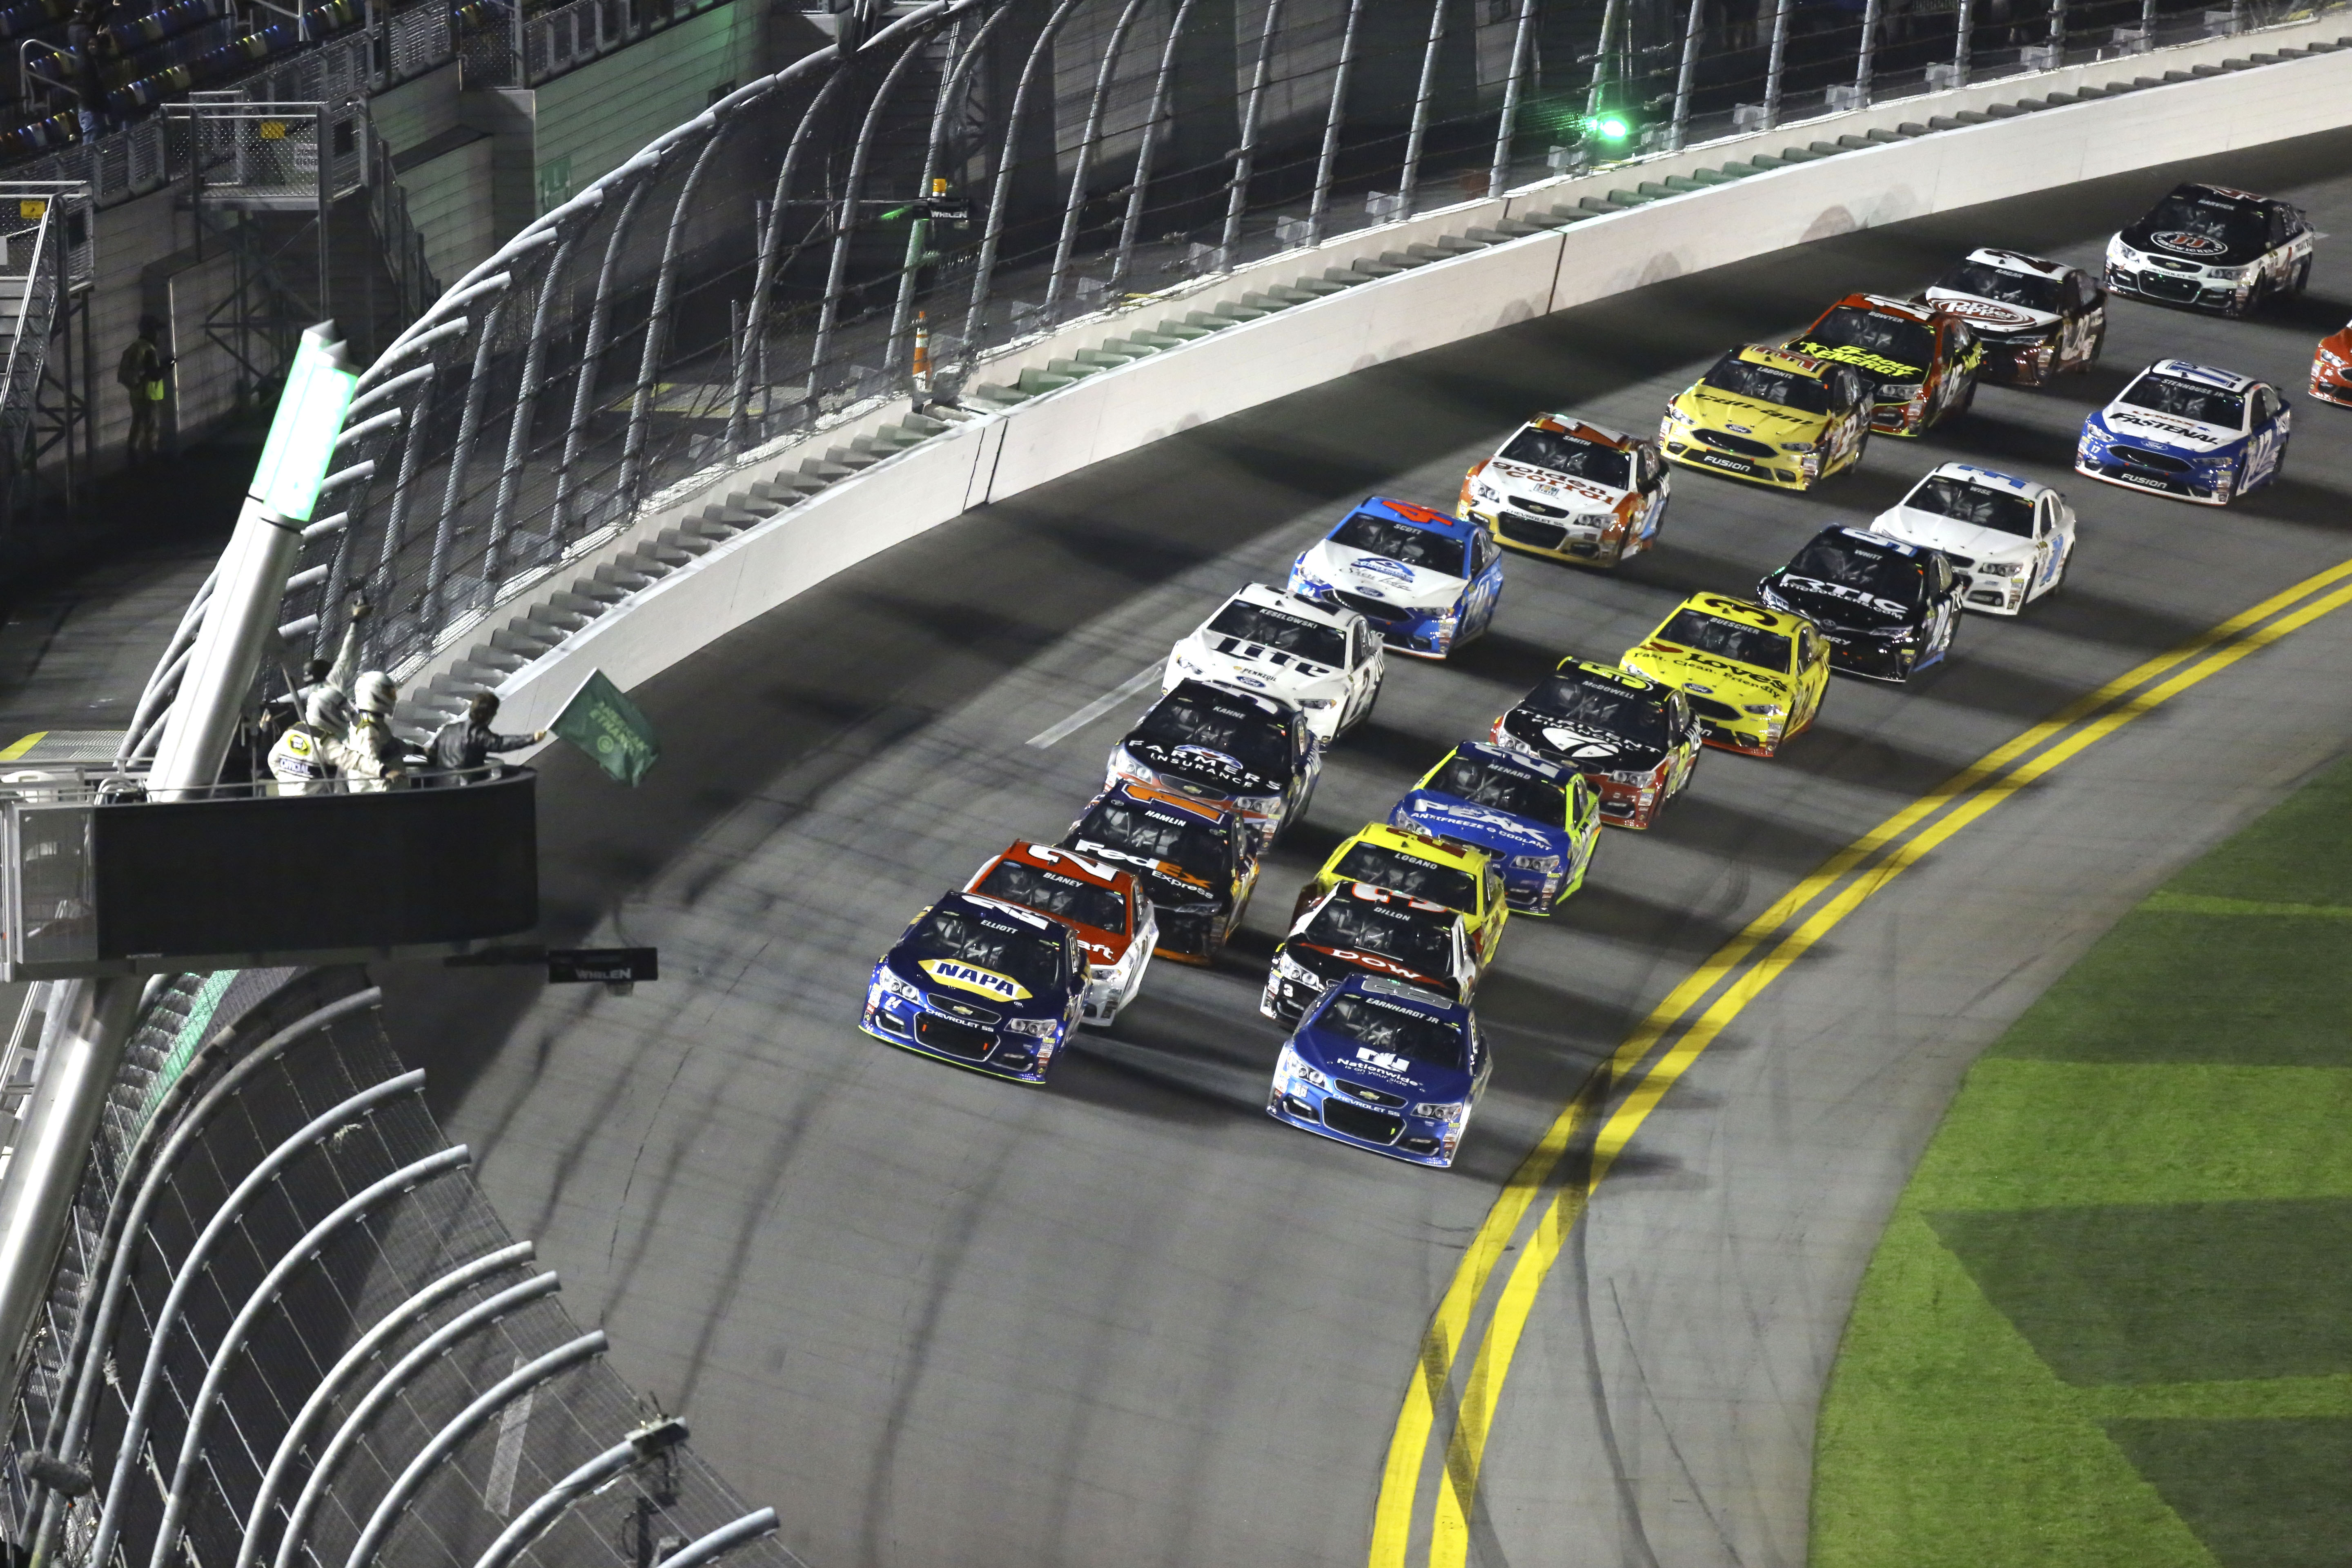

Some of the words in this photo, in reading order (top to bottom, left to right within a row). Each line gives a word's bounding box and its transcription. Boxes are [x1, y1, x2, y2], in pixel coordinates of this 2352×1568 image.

[931, 210, 967, 218] WHELEN
[1995, 268, 2024, 278] RAGAN
[1868, 311, 1904, 323] BOWYER
[1944, 301, 2018, 320] Pepper
[1813, 350, 1914, 376] ENERGY
[1833, 345, 1923, 372] 5-hour
[1757, 366, 1795, 379] LABONTE
[2161, 379, 2213, 394] STENHOUSE
[2108, 412, 2218, 445] FASTENAL
[1562, 435, 1592, 446] SMITH
[2091, 444, 2101, 454] 17
[1704, 455, 1751, 472] FUSION
[1492, 461, 1607, 495] golden
[2121, 473, 2167, 489] FUSION
[1506, 471, 1615, 505] corral
[1969, 486, 1993, 496] WISE
[1506, 508, 1550, 524] CHEVROLET
[1393, 523, 1423, 535] SCOTT
[1780, 573, 1909, 614] RTIC
[1259, 608, 1319, 629] KESELOWSKI
[1710, 617, 1761, 635] BUESCHER
[1819, 633, 1852, 646] MRY
[1243, 668, 1277, 682] PENNZOIL
[1581, 680, 1635, 699] McDOWELL
[1689, 684, 1708, 693] Ford
[1213, 706, 1246, 720] KAHNE
[1517, 709, 1662, 753] THRIVENT
[1128, 740, 1283, 790] FARMERS
[1150, 752, 1254, 788] INSURANCE
[1487, 764, 1532, 780] MENARD
[1145, 810, 1187, 827] HAMLIN
[1413, 798, 1552, 846] PEAK
[1410, 813, 1485, 829] ANTIFREEZE
[1498, 830, 1552, 851] COOLANT
[1394, 853, 1438, 870] LOGANO
[1043, 872, 1085, 888] BLANEY
[1151, 870, 1214, 899] Express
[1373, 907, 1411, 921] DILLON
[980, 919, 1018, 934] ELLIOTT
[1330, 949, 1421, 979] DOW
[937, 962, 1014, 996] NAPA
[1283, 983, 1294, 998] 3
[885, 996, 902, 1009] 24
[1365, 998, 1426, 1019] EARNHARDT
[1425, 1015, 1440, 1024] JR
[925, 1008, 980, 1029] CHEVROLET
[1336, 1058, 1419, 1086] Nationwide
[1368, 1071, 1388, 1079] your
[1390, 1077, 1408, 1087] side
[1332, 1093, 1386, 1114] CHEVROLET
